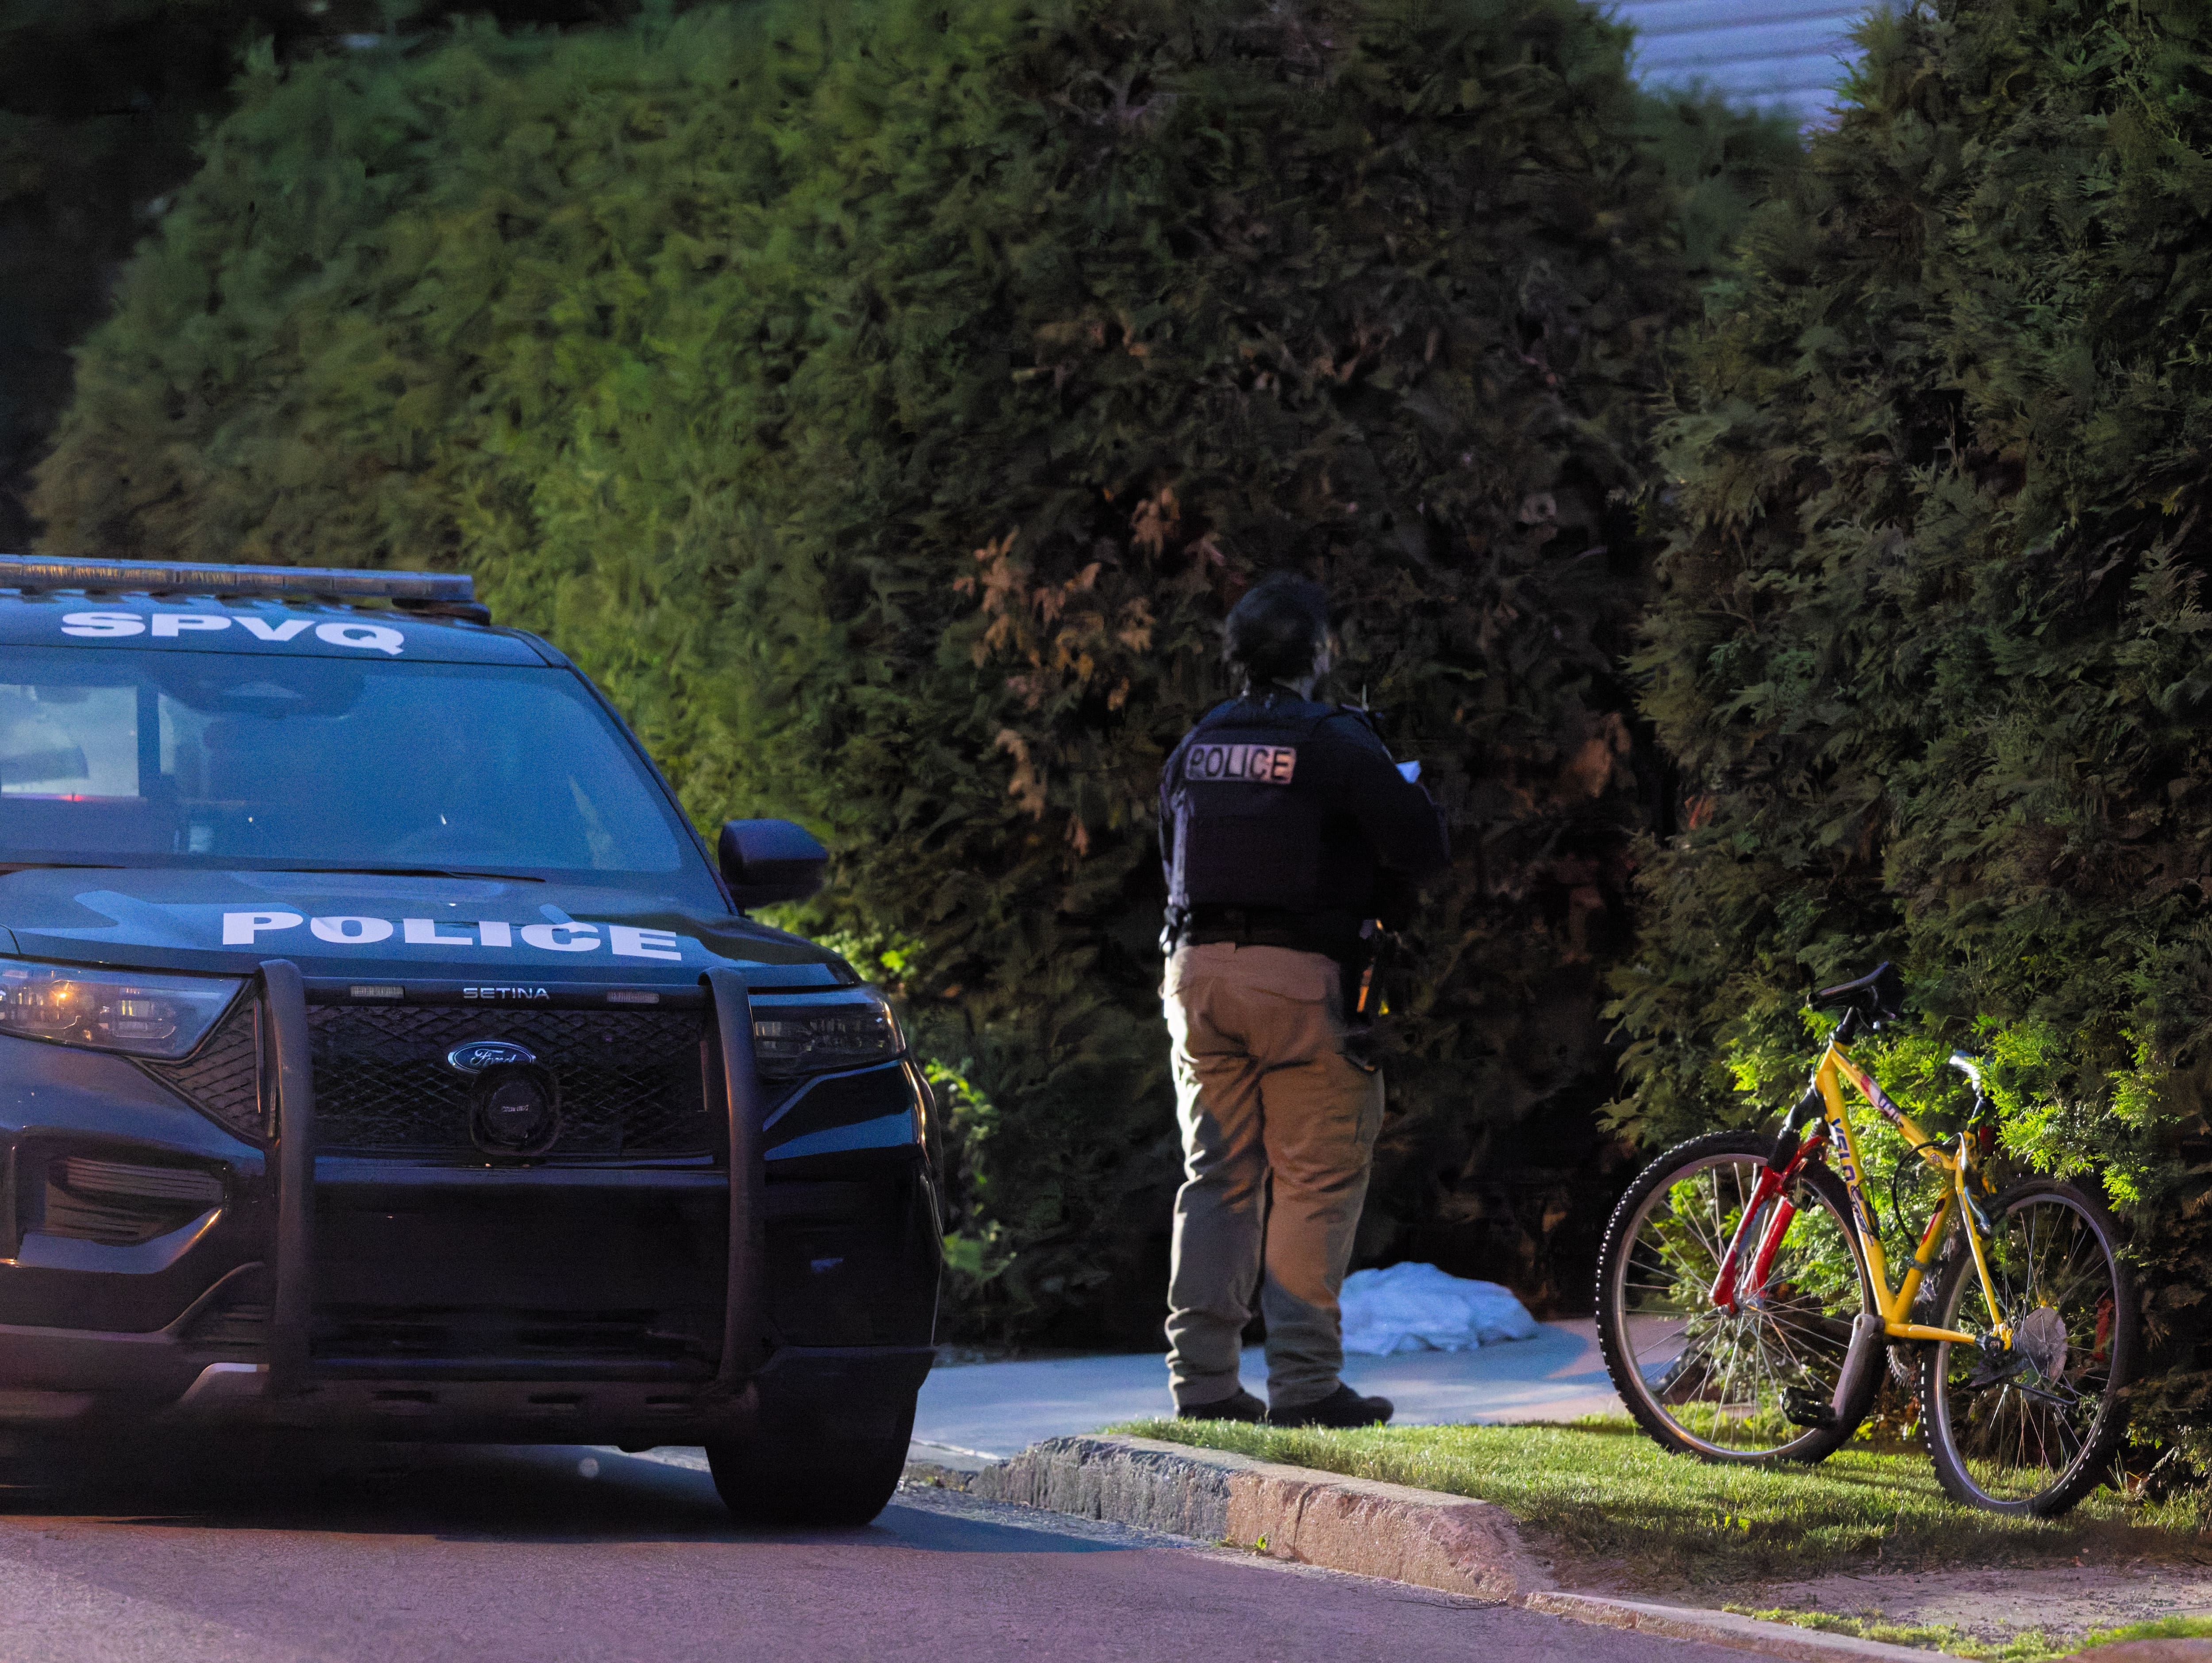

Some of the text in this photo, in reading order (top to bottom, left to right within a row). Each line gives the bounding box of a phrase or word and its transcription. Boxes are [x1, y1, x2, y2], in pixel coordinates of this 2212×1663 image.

[61, 612, 404, 655] SPVQ
[1189, 747, 1291, 780] POLICE
[222, 911, 682, 961] POLICE
[463, 988, 549, 999] SETINA
